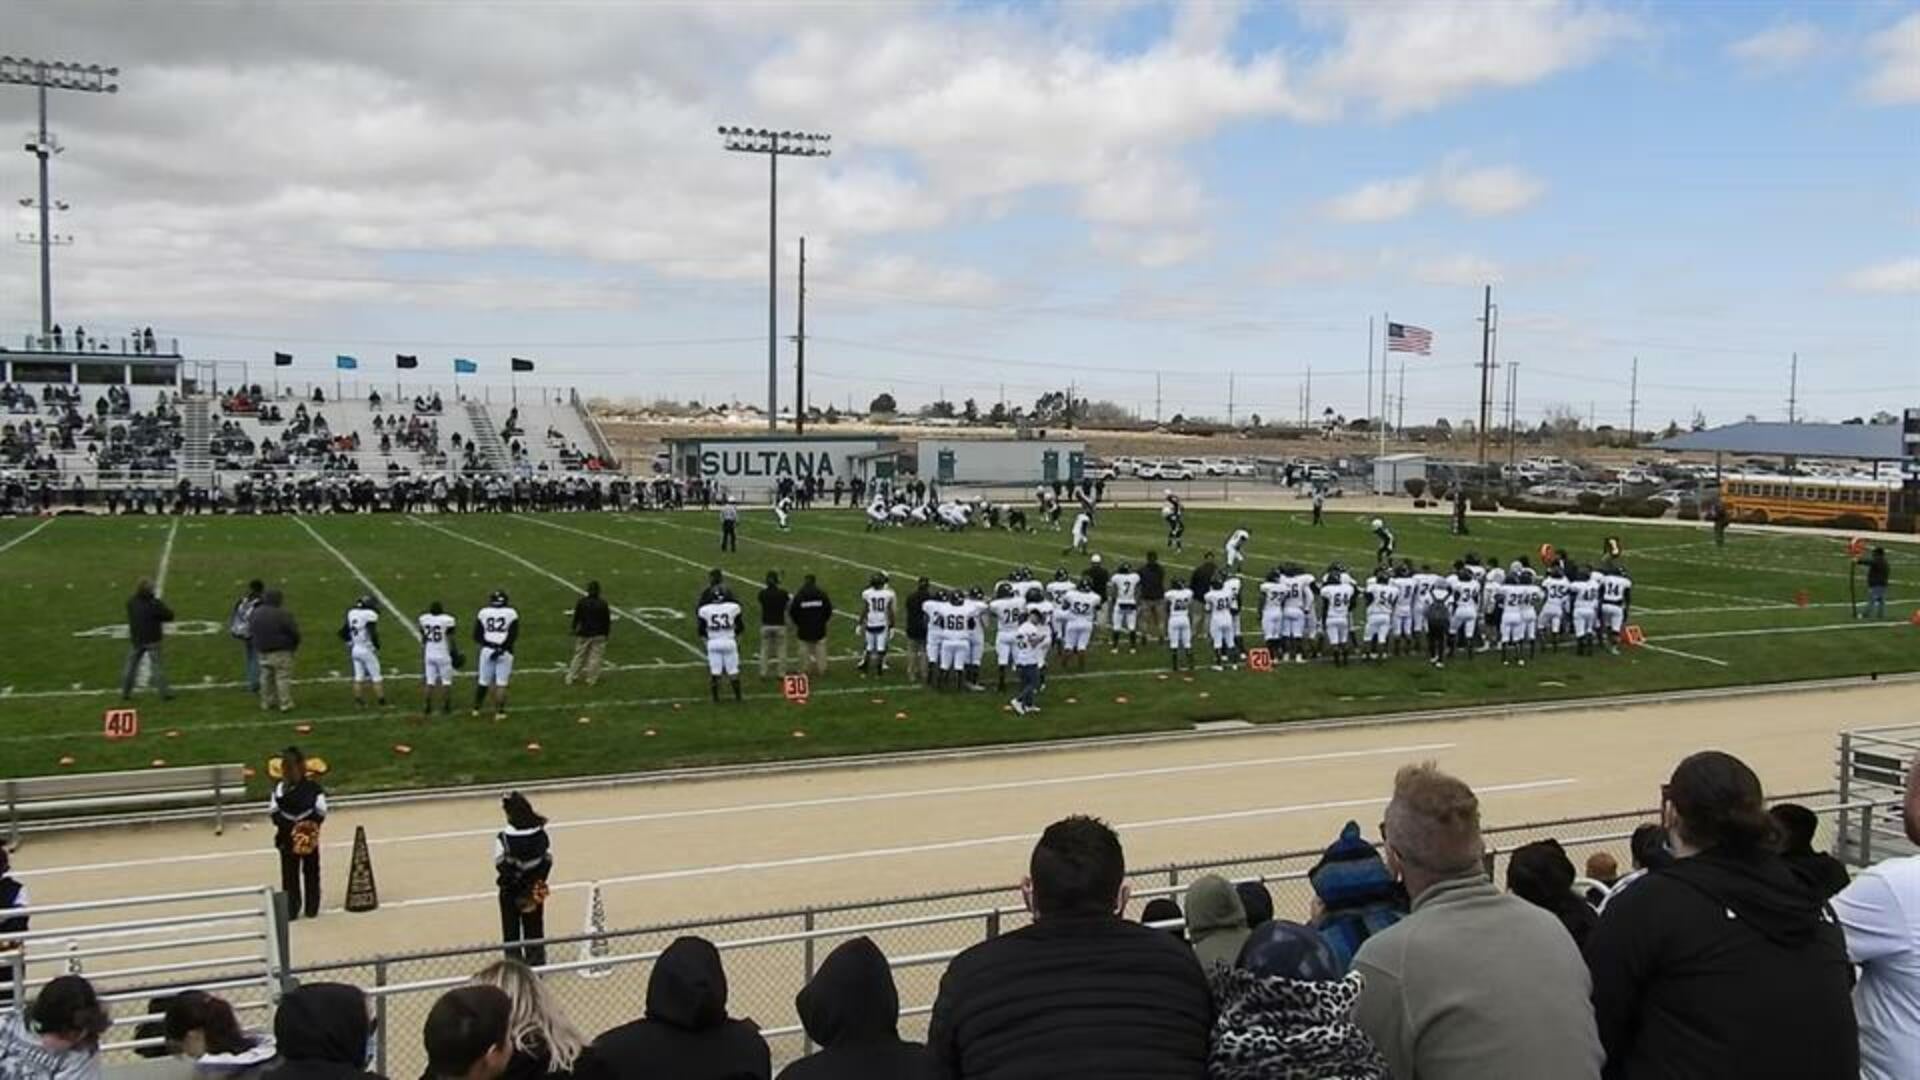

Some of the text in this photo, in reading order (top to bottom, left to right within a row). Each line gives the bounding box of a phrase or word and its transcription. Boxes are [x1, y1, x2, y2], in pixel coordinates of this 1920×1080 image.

[702, 452, 833, 477] SULTANA
[871, 597, 885, 612] 10
[486, 617, 507, 633] 82
[711, 613, 731, 631] 53
[947, 614, 964, 631] 66
[424, 625, 443, 642] 26
[1253, 651, 1269, 667] 20
[786, 676, 807, 696] 30
[107, 710, 134, 735] 40
